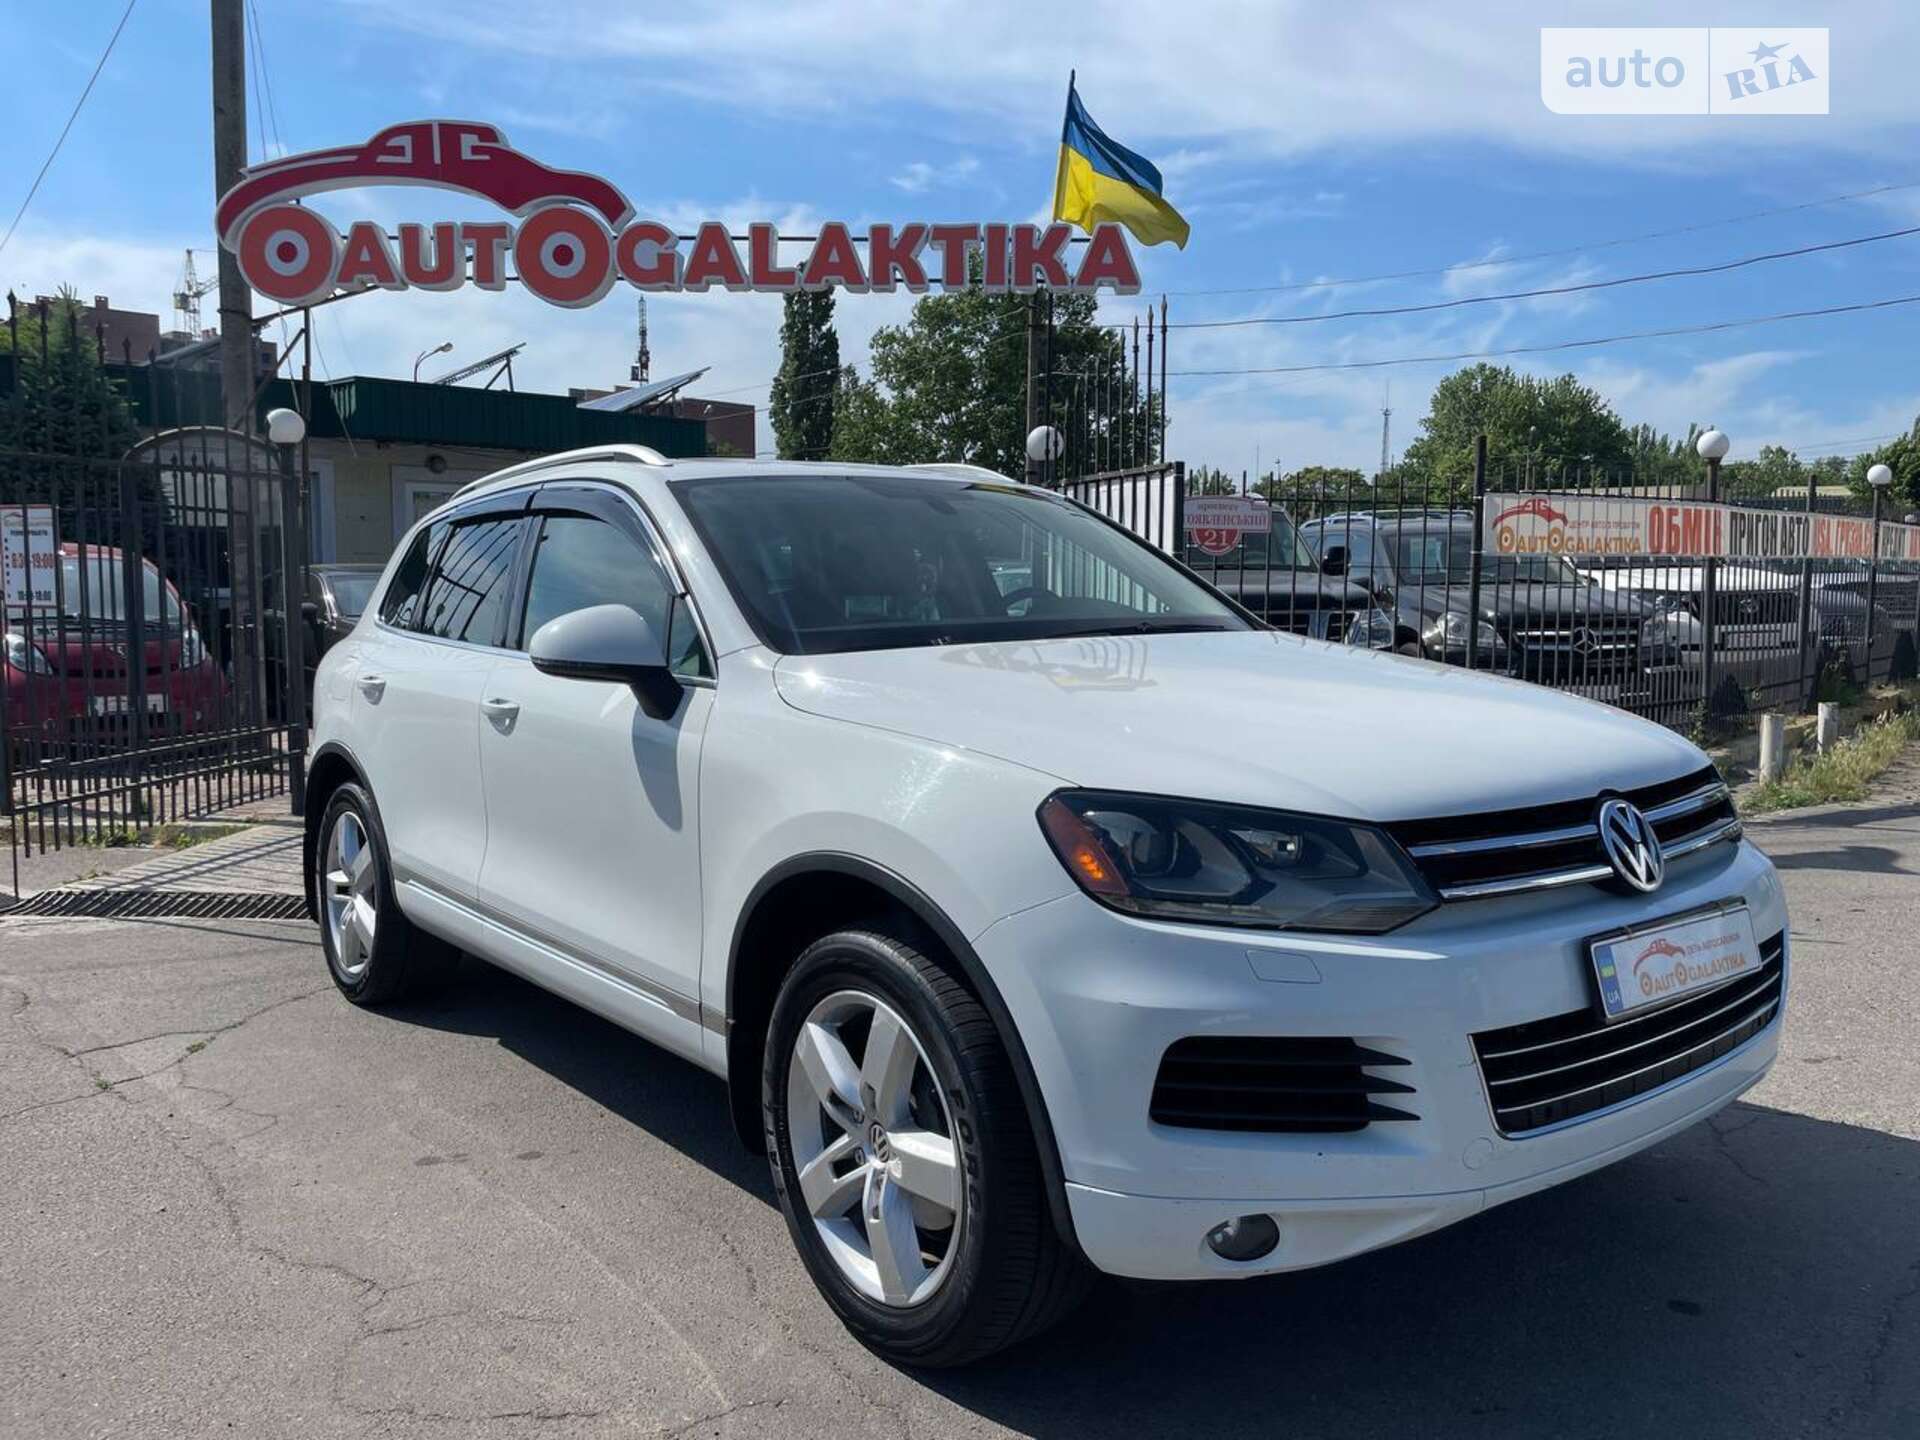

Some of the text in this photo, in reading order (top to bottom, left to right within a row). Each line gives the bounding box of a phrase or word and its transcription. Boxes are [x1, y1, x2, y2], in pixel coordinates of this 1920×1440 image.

[1203, 529, 1229, 546] 21
[1649, 506, 1722, 555] ОБМІН
[1729, 512, 1778, 556] ПРИГОН
[1779, 514, 1811, 557] АВТО
[1607, 991, 1620, 1003] UA
